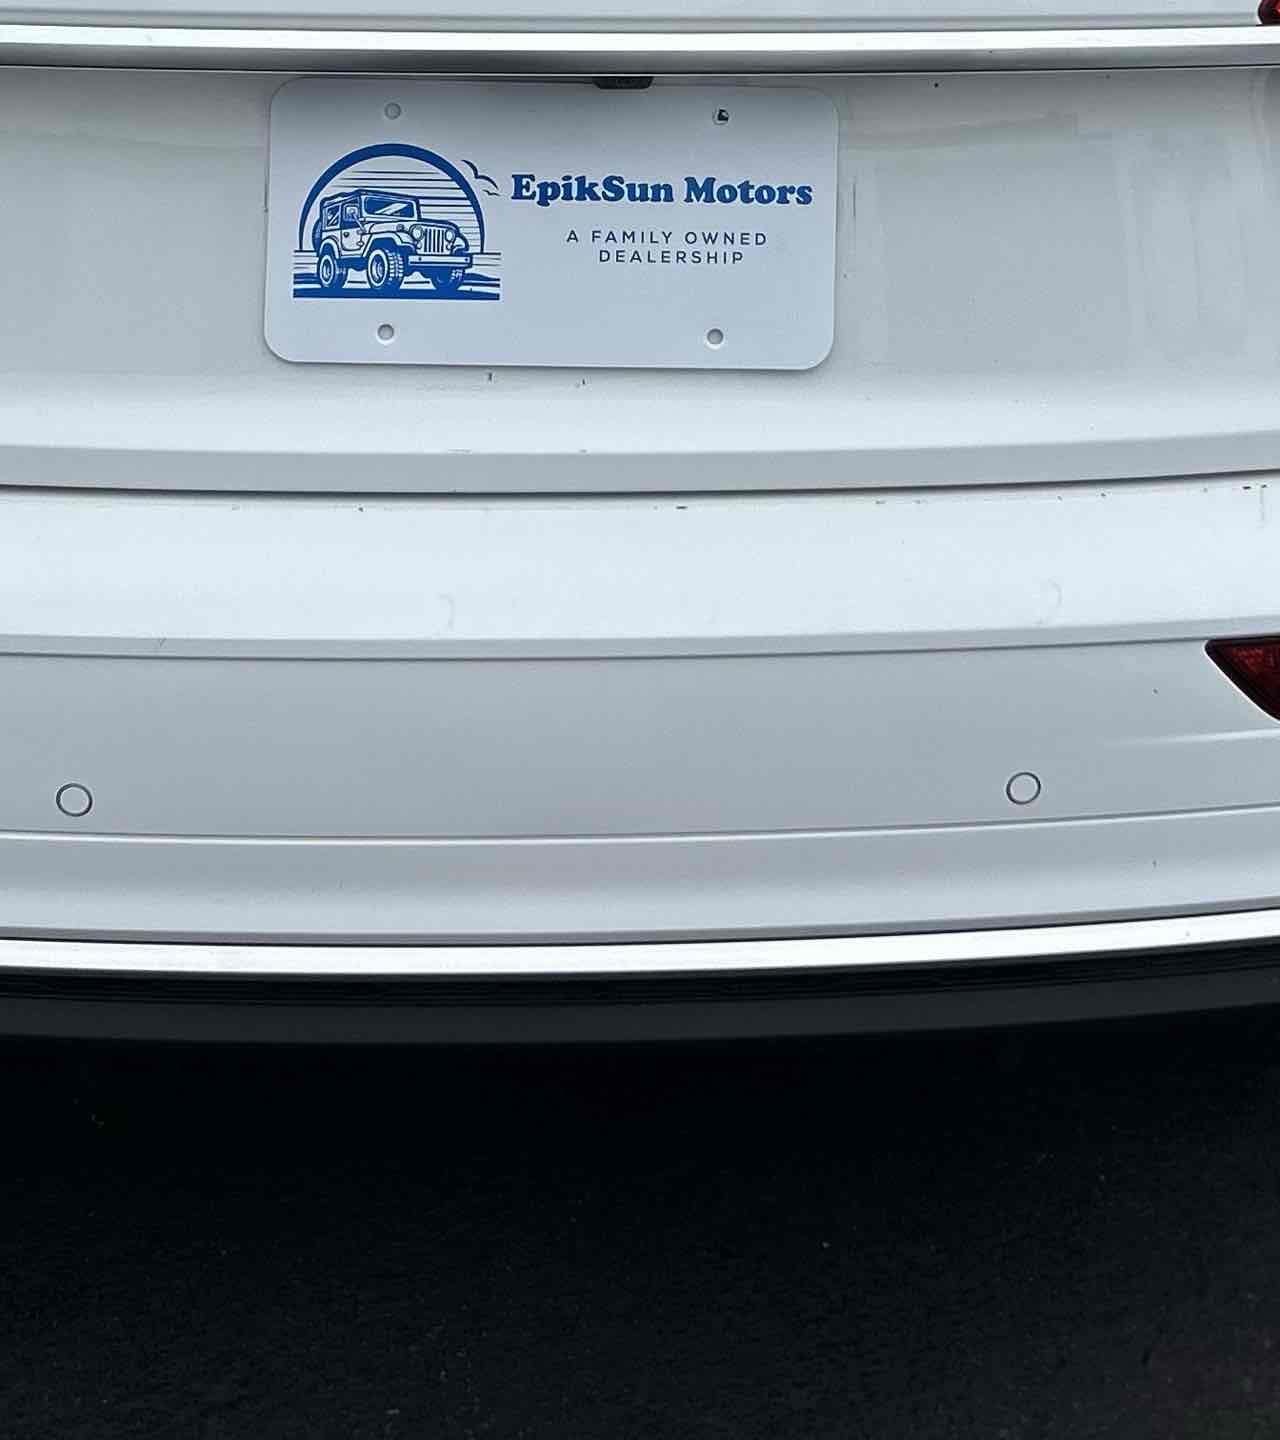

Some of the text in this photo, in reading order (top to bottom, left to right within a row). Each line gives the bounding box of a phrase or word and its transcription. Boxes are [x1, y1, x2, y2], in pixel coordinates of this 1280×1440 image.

[511, 173, 813, 207] EpikSun Motors
[566, 229, 767, 245] A FAMILY OWNED
[599, 249, 744, 264] DEALERSHIP
